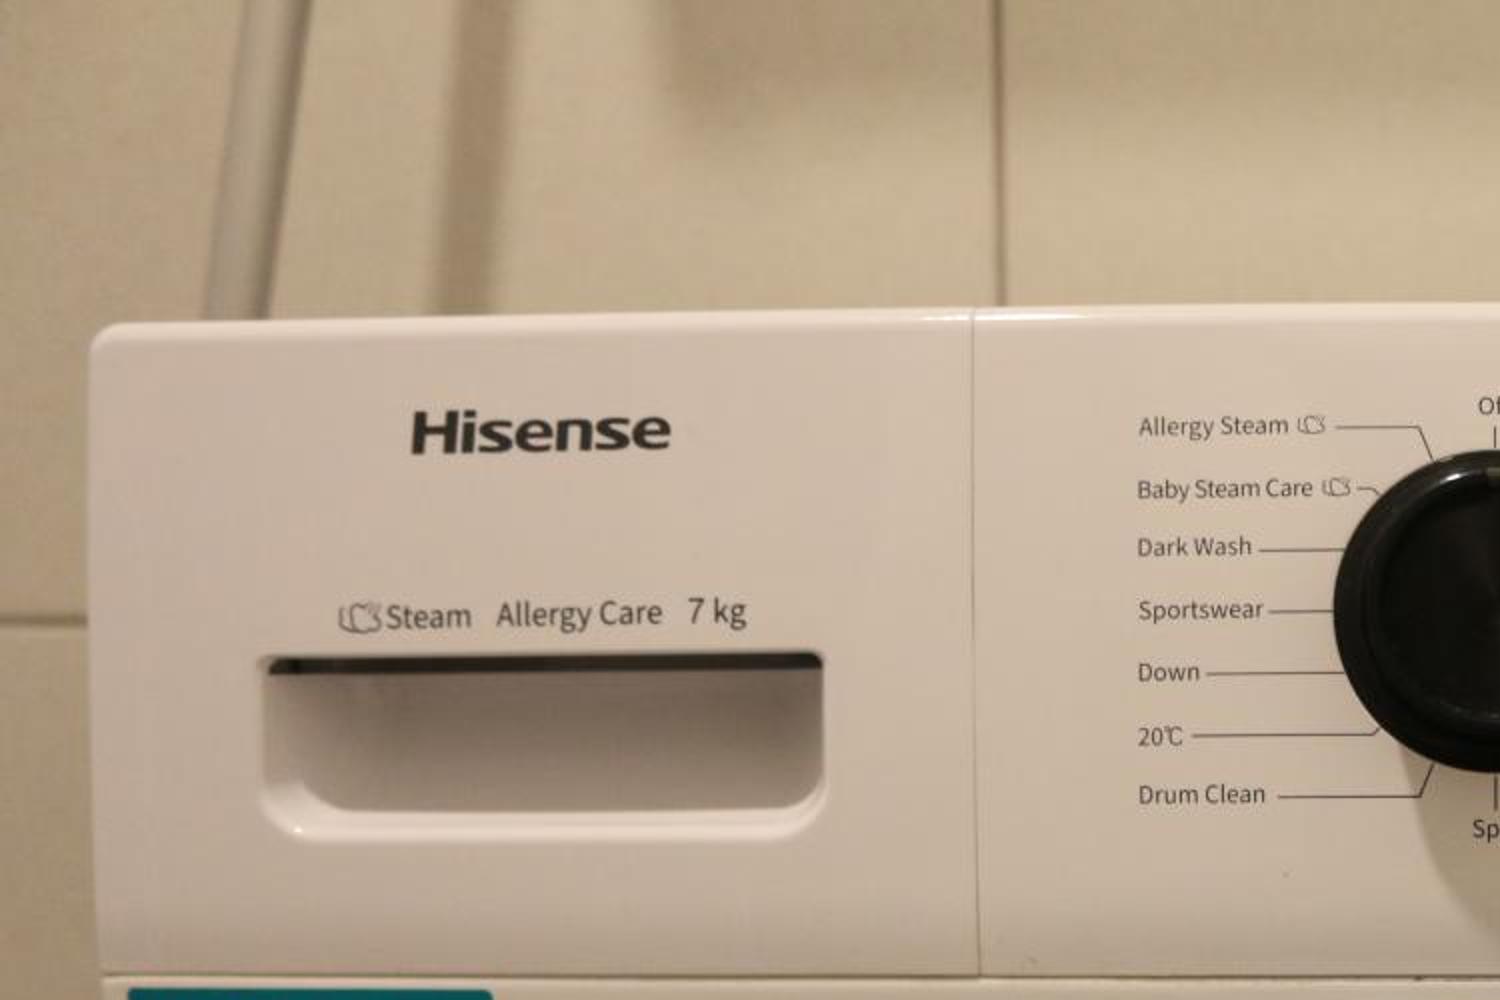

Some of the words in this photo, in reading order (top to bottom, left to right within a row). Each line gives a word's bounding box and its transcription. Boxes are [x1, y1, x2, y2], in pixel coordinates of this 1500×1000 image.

[411, 410, 671, 455] Hisense
[1139, 416, 1214, 441] Allergy
[1221, 416, 1288, 435] Steam
[1138, 480, 1190, 504] Baby
[1195, 480, 1260, 498] Steam
[1266, 478, 1313, 497] Care
[1138, 537, 1188, 557] Dark
[1194, 536, 1252, 556] Wash
[387, 604, 471, 630] Steam
[496, 600, 592, 634] Allergy
[600, 600, 662, 626] Care
[688, 597, 704, 624] 7
[714, 597, 747, 631] kg
[1139, 601, 1264, 624] Sportswear
[1138, 663, 1200, 682] Down
[1139, 785, 1198, 804] Drum
[1205, 784, 1265, 804] Clean
